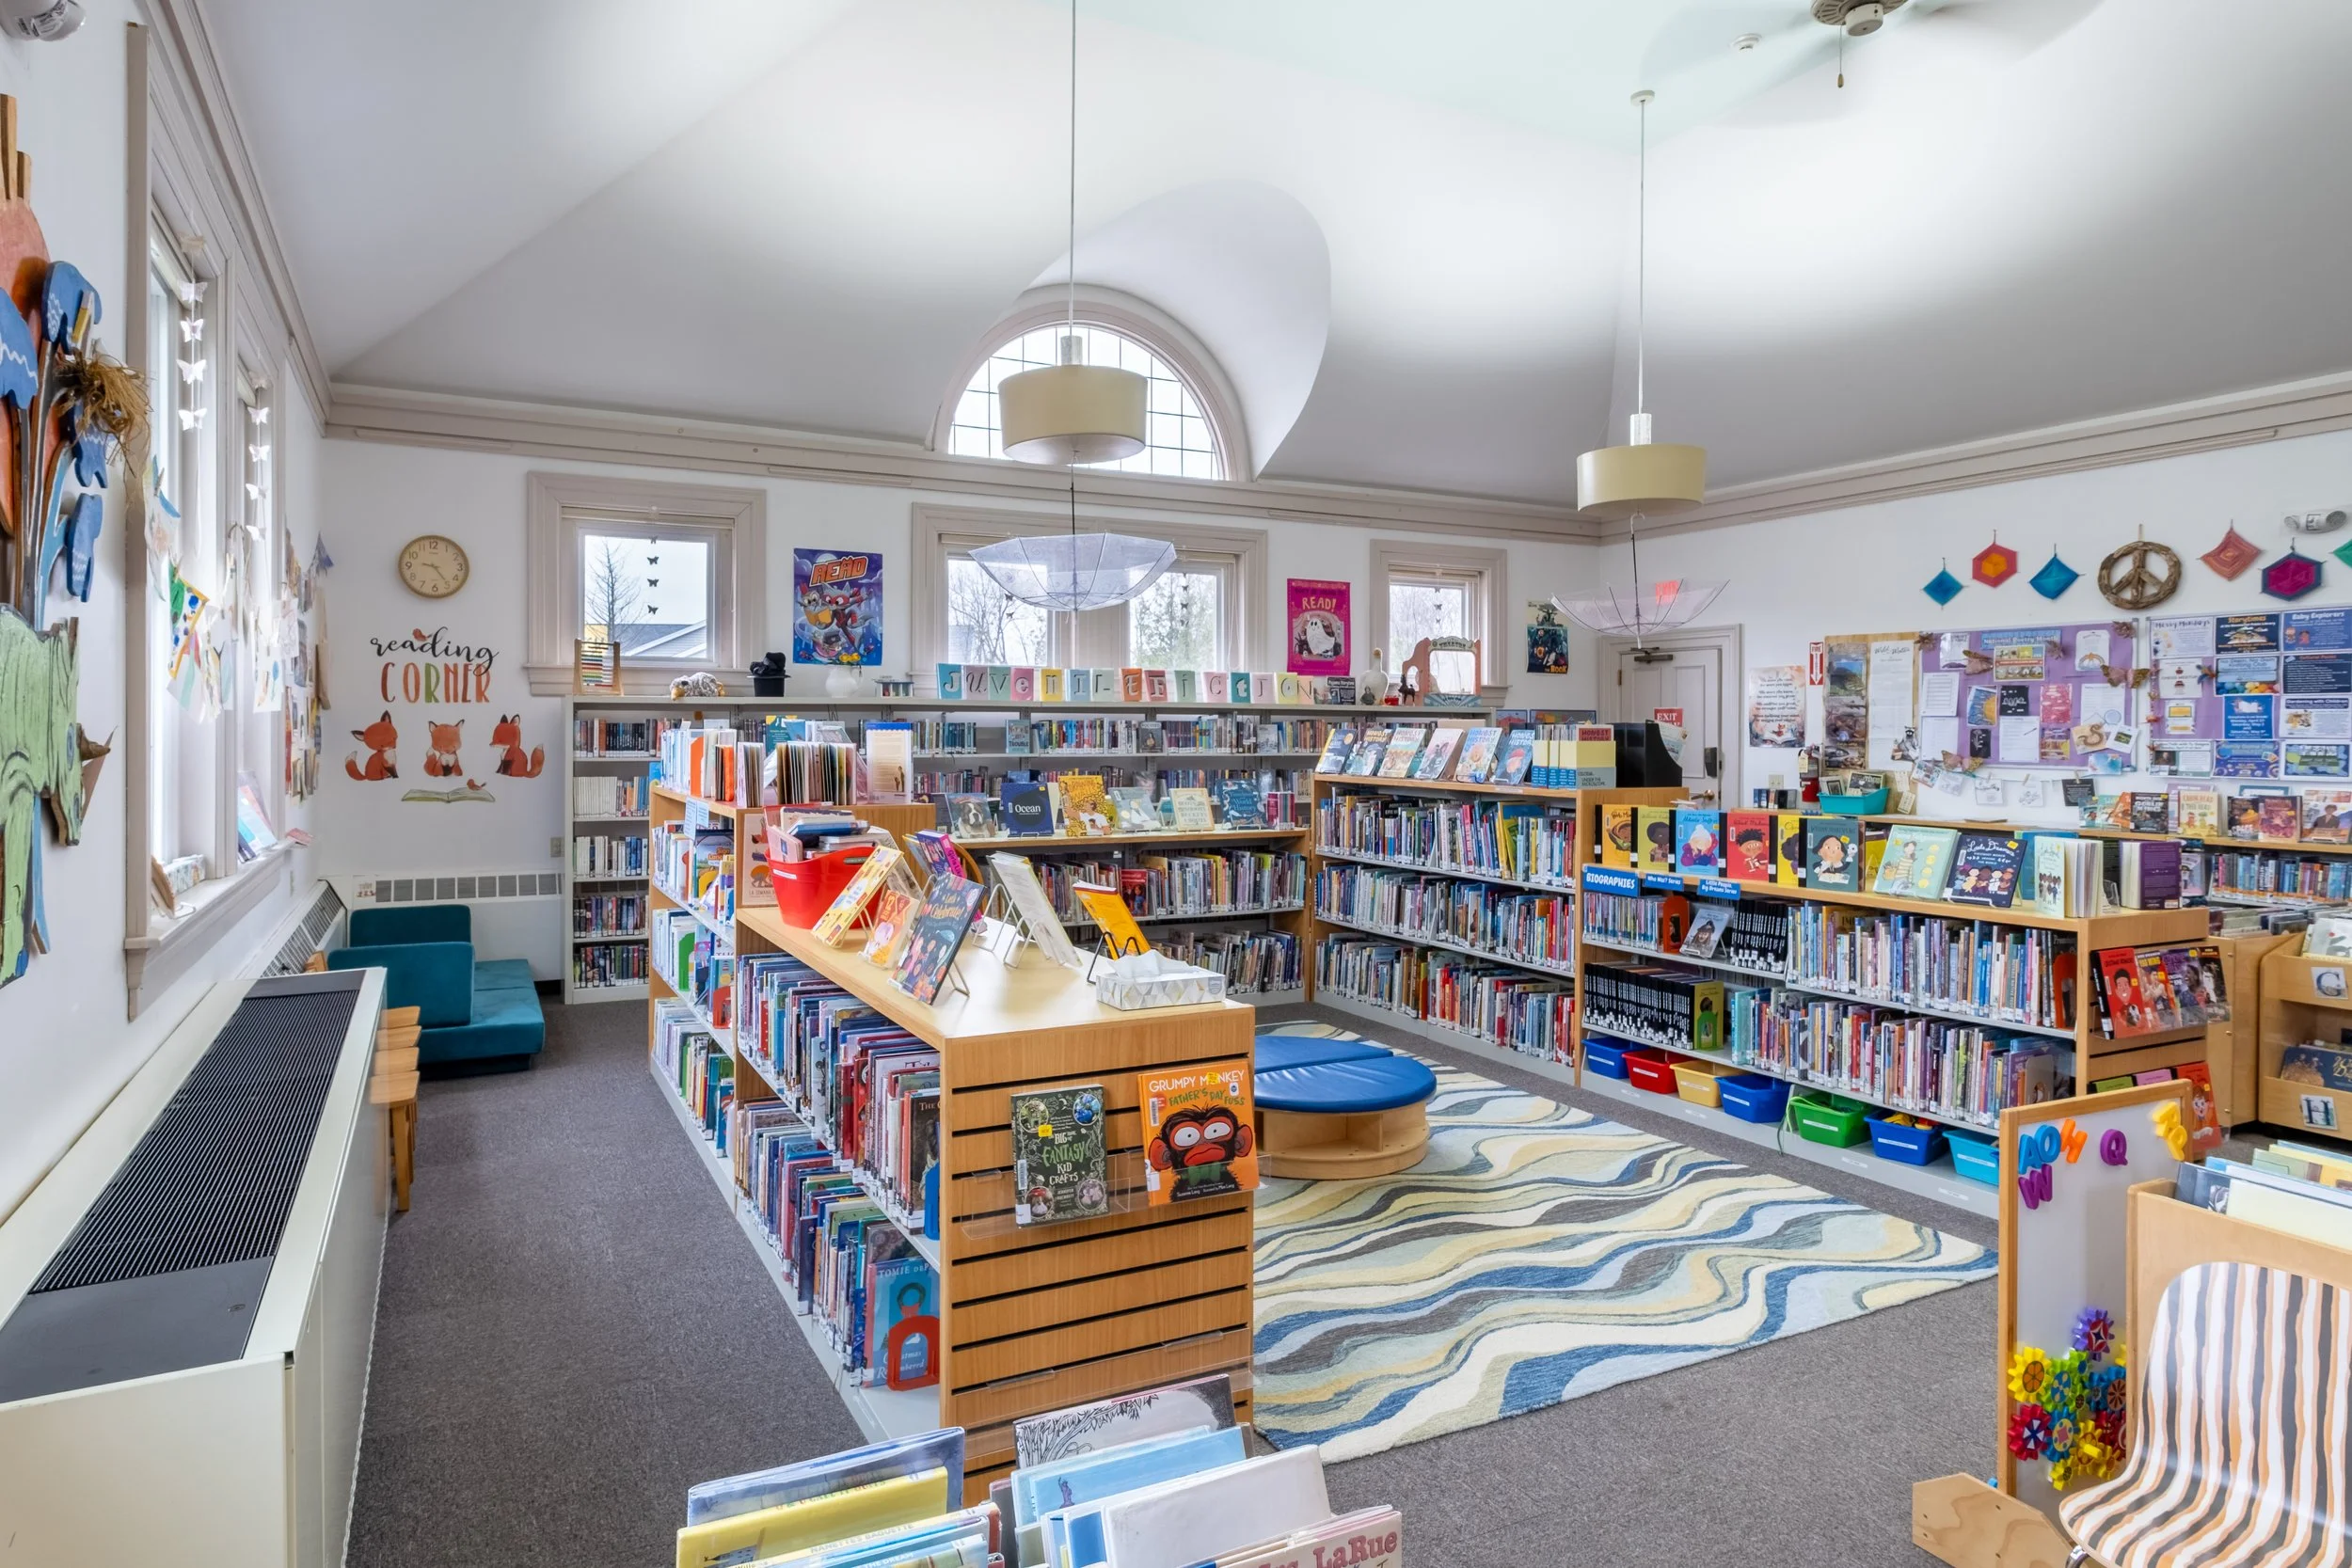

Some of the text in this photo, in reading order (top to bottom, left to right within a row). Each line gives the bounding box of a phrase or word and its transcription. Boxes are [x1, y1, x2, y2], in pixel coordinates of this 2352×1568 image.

[429, 541, 438, 549] 12
[408, 551, 419, 560] 10
[405, 562, 412, 570] 9
[456, 562, 463, 571] 3
[811, 556, 867, 585] READ
[409, 572, 416, 580] 8
[432, 583, 438, 592] 6
[444, 580, 451, 589] 5
[1302, 596, 1337, 612] READ!
[370, 626, 500, 677] reading
[381, 662, 490, 704] CORNER
[1657, 712, 1677, 721] EXIT
[1014, 804, 1041, 813] Ocean
[1586, 872, 1635, 890] BIOGRAPHIES
[2316, 972, 2341, 997] G
[1149, 1069, 1245, 1093] GRUMPY MNKEY
[1168, 1088, 1245, 1106] FATHER'S DAY FUSS
[2306, 1097, 2332, 1126] H
[1055, 1132, 1068, 1144] BIG
[1041, 1141, 1086, 1167] FANTASY
[2100, 1129, 2128, 1165] Q
[2018, 1134, 2042, 1175] A
[1057, 1163, 1073, 1174] KID
[1049, 1172, 1079, 1185] CRAFTS
[879, 1266, 911, 1279] TOMIE
[1313, 1531, 1398, 1568] LaRue
